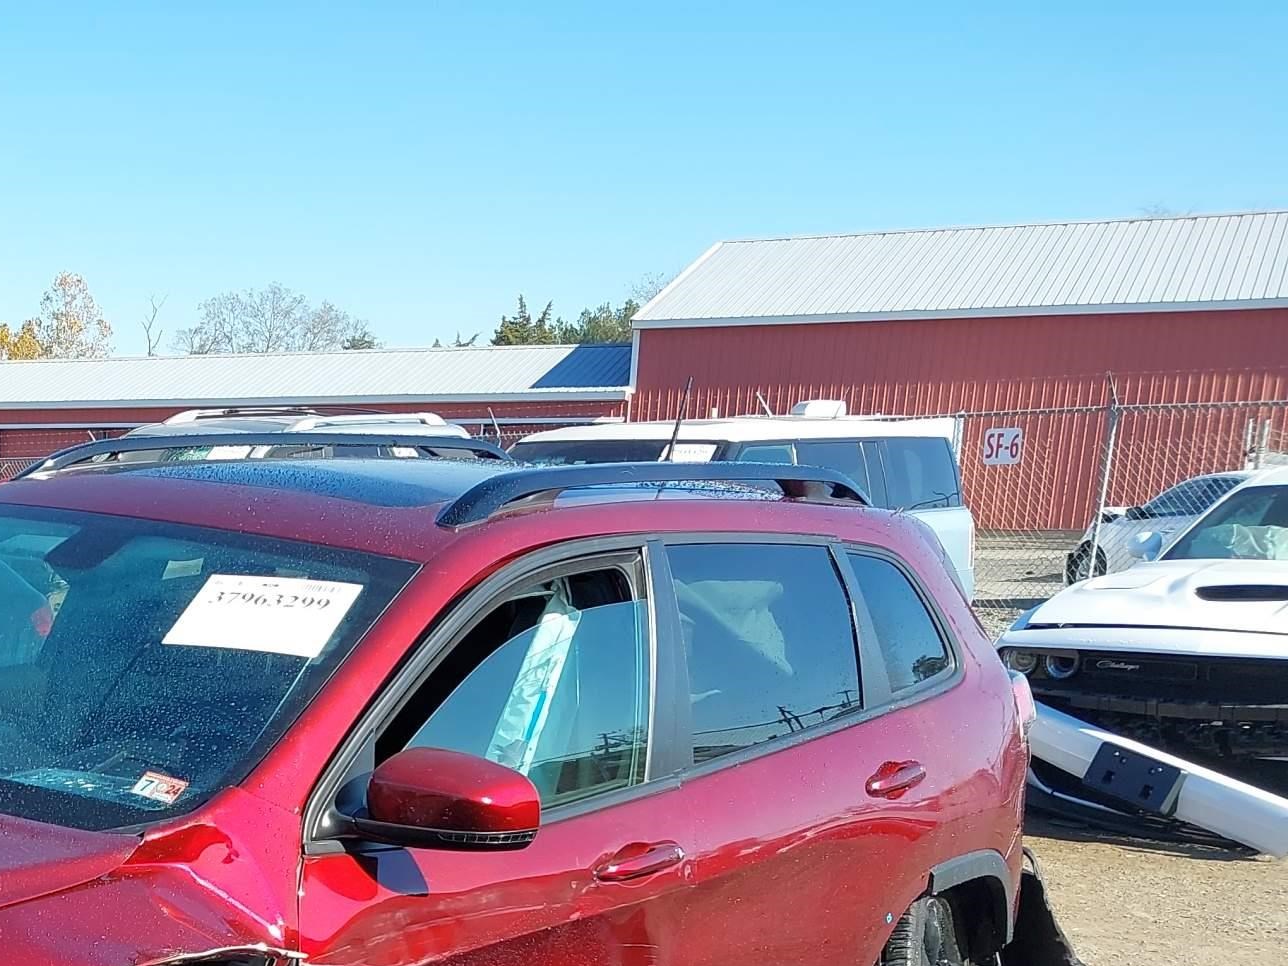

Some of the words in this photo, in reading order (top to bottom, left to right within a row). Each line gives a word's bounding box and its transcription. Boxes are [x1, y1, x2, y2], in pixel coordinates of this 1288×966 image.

[985, 432, 1019, 459] SF-6
[209, 591, 331, 610] 37963299
[140, 779, 155, 792] 7
